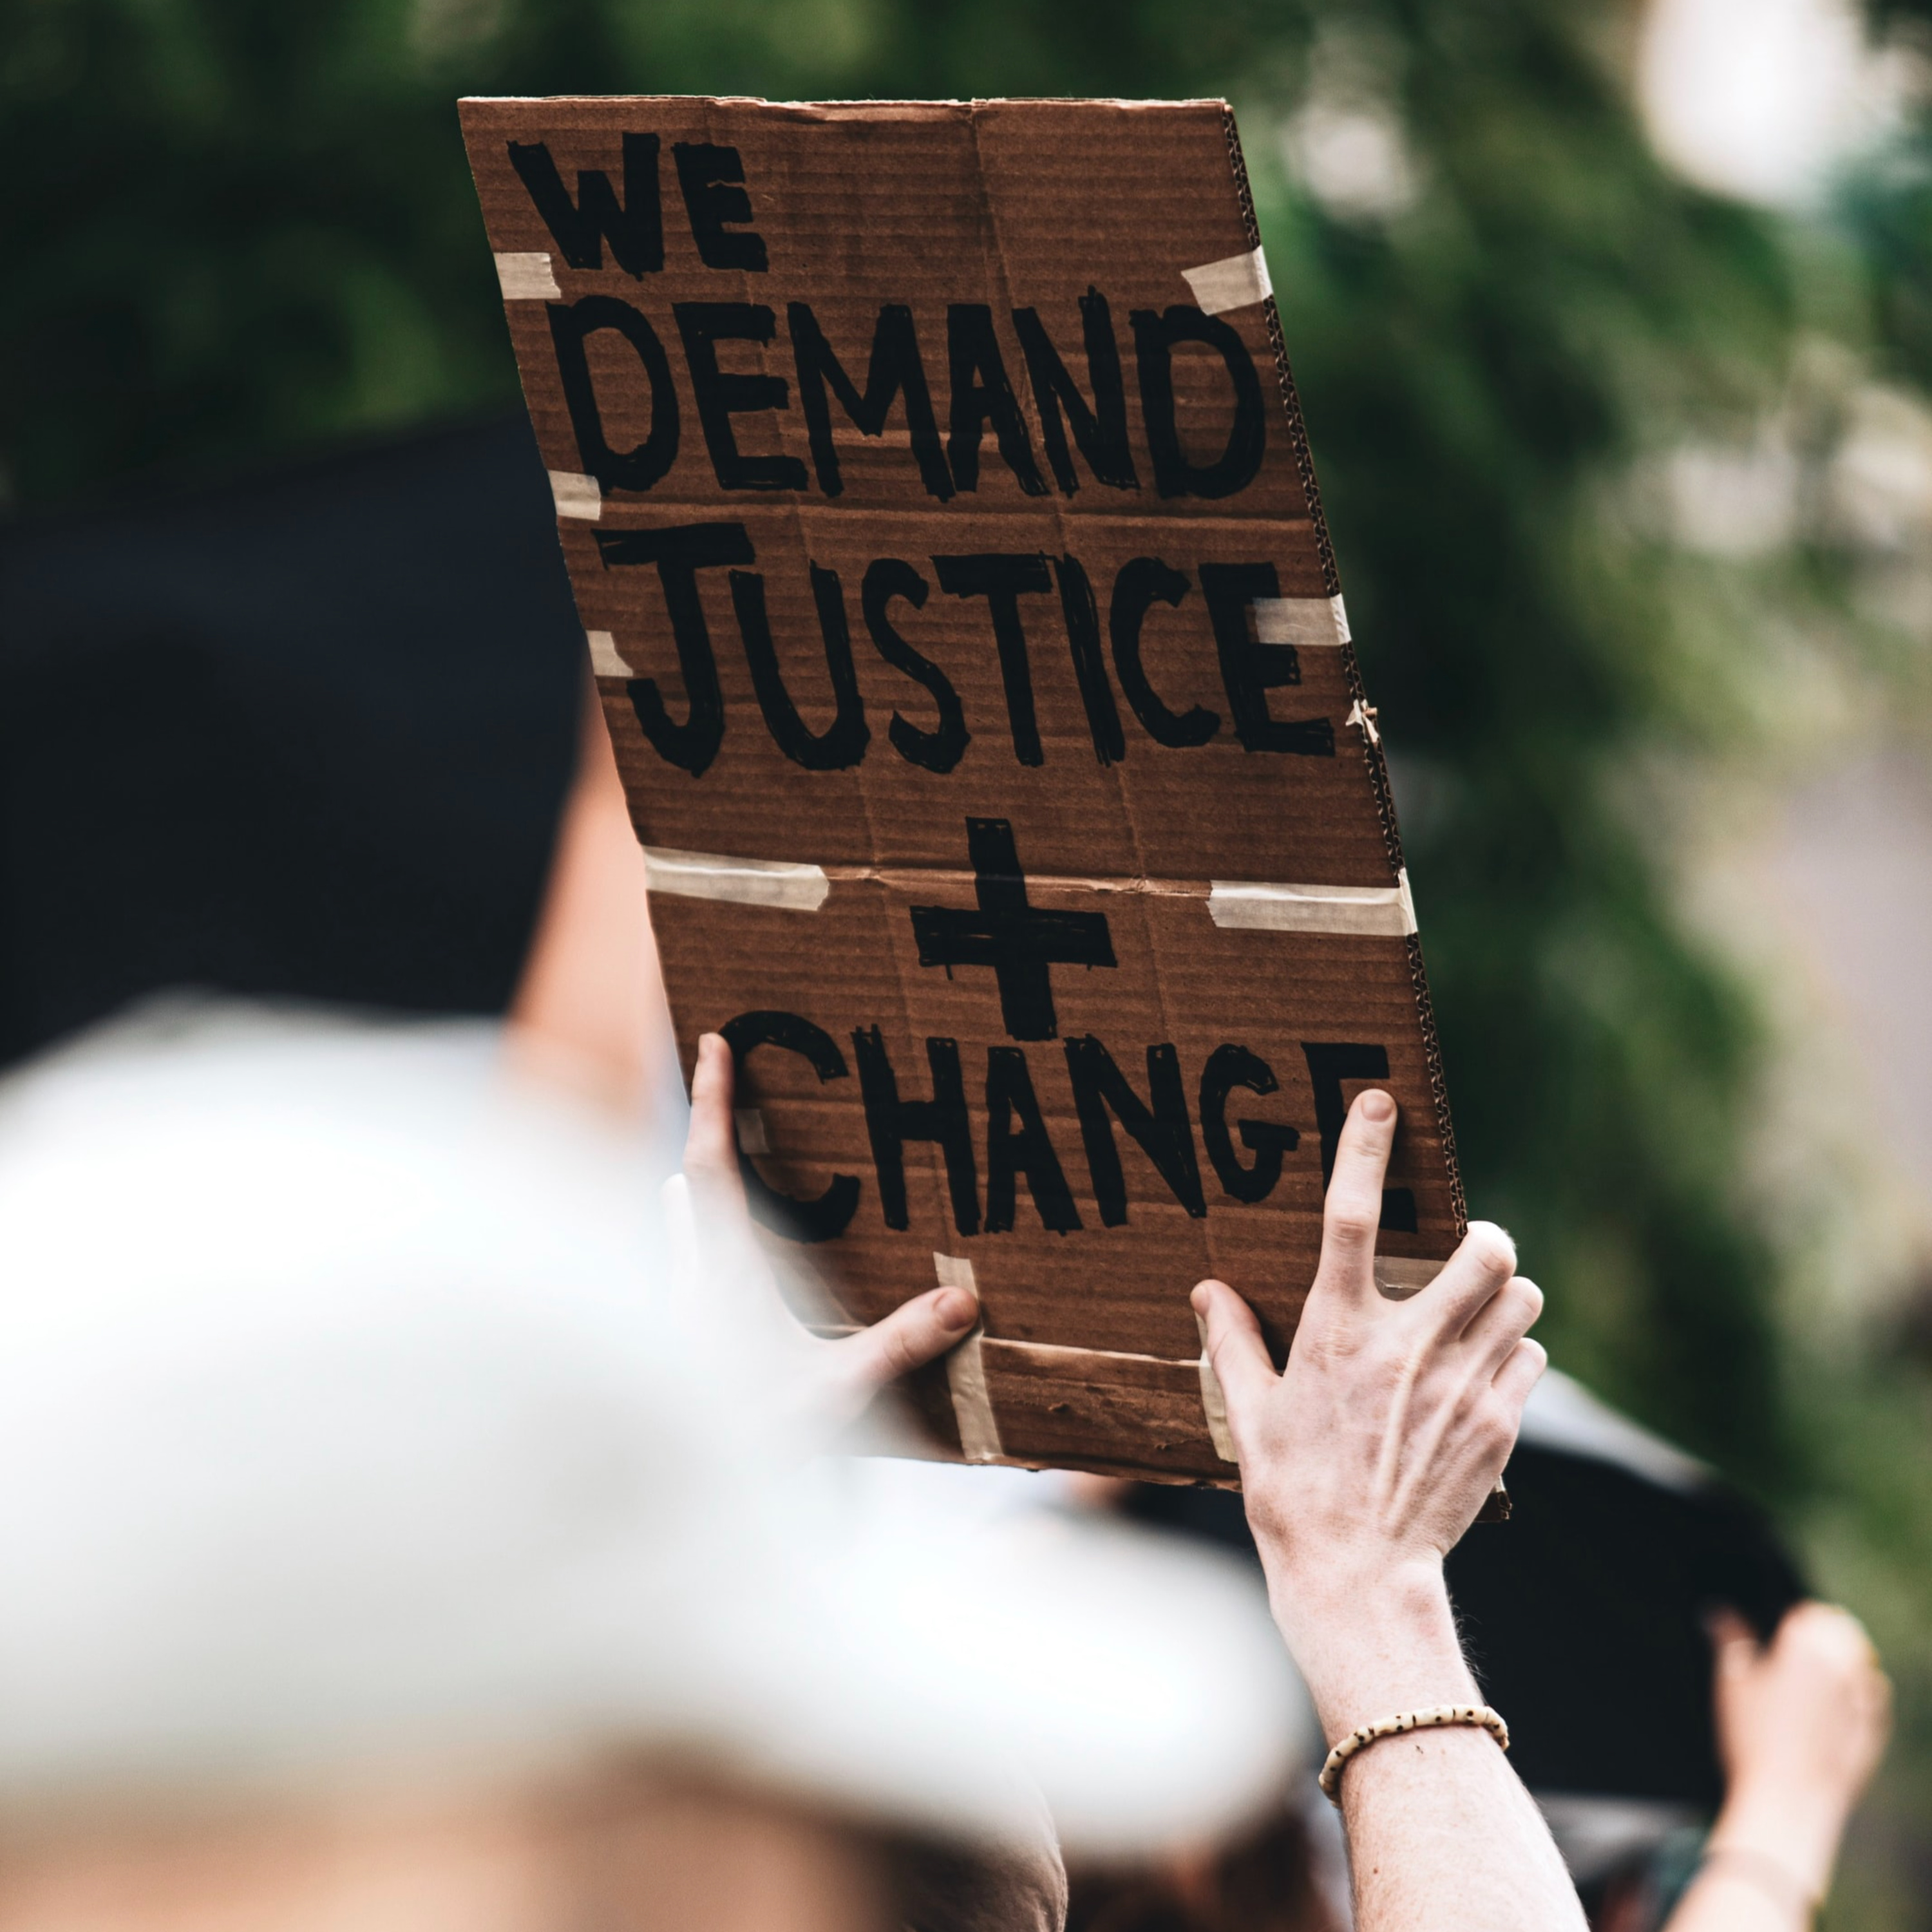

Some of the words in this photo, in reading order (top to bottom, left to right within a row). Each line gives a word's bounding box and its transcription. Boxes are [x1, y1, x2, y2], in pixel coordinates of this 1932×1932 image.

[507, 132, 768, 280] WE
[545, 285, 1266, 502] DEMAND
[592, 522, 1335, 777] JUSTICE
